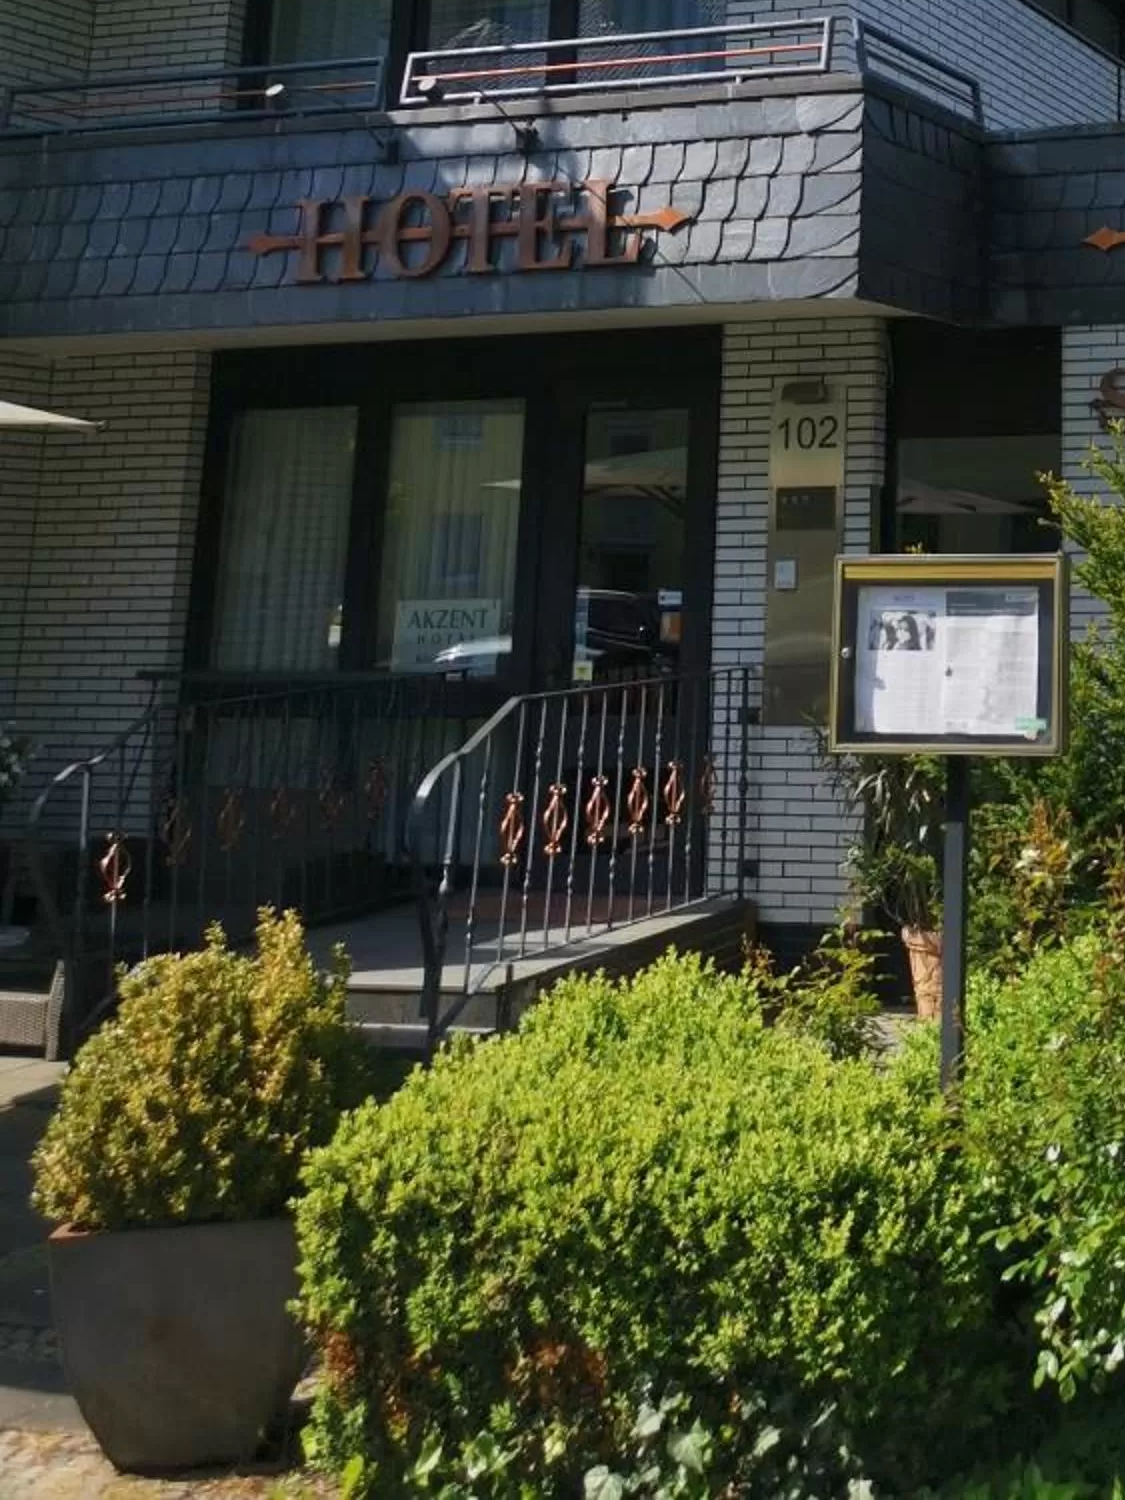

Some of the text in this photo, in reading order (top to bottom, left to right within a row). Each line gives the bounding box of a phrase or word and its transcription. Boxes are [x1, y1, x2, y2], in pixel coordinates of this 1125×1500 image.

[297, 180, 640, 283] HOTEL
[777, 415, 840, 450] 102
[408, 608, 489, 629] AKZENT
